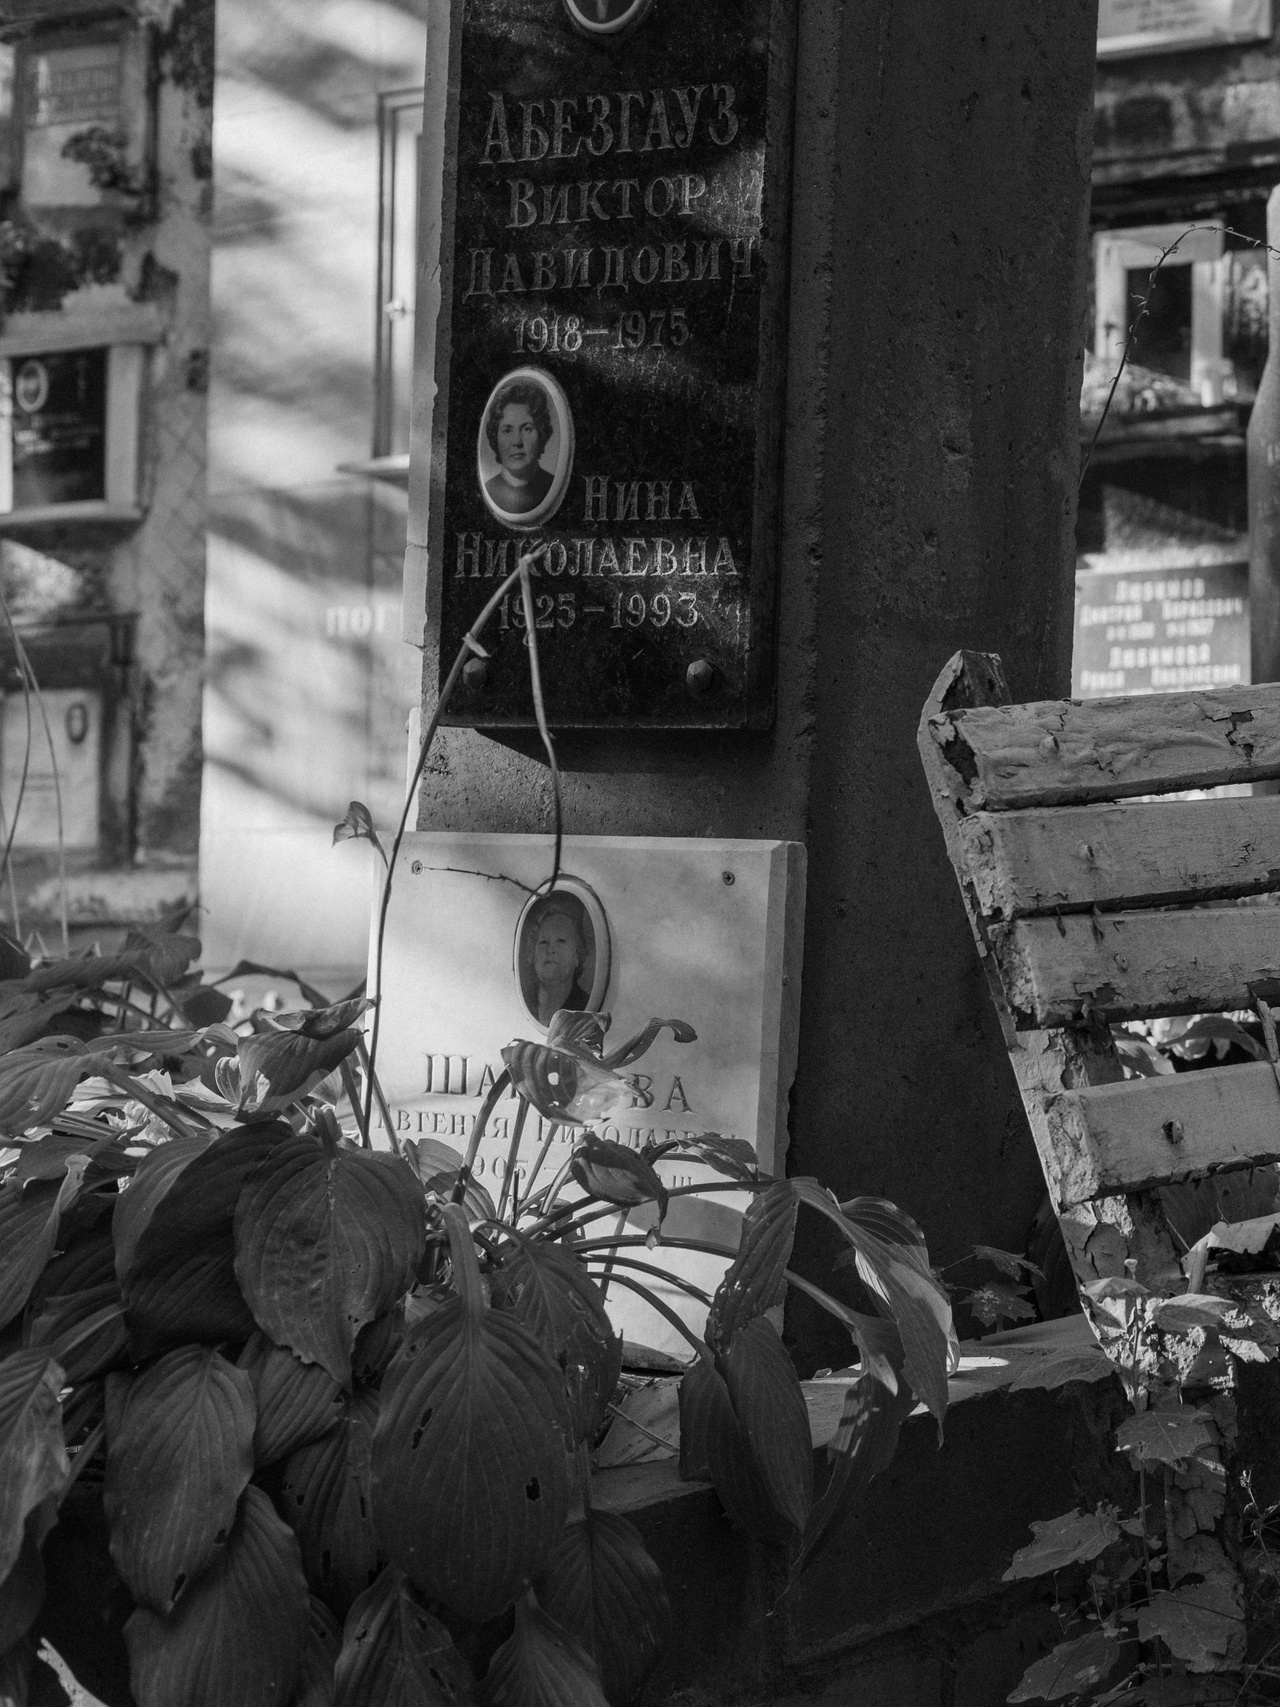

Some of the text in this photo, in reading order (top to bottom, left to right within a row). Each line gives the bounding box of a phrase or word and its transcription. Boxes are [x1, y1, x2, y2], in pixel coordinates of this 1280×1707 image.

[477, 82, 740, 165] АБЕЗГАУЗ
[505, 173, 707, 229] ВИКТОР
[462, 237, 757, 304] ДАВИДОВИЧ
[582, 475, 702, 522] НИНА
[462, 1154, 529, 1180] 905
